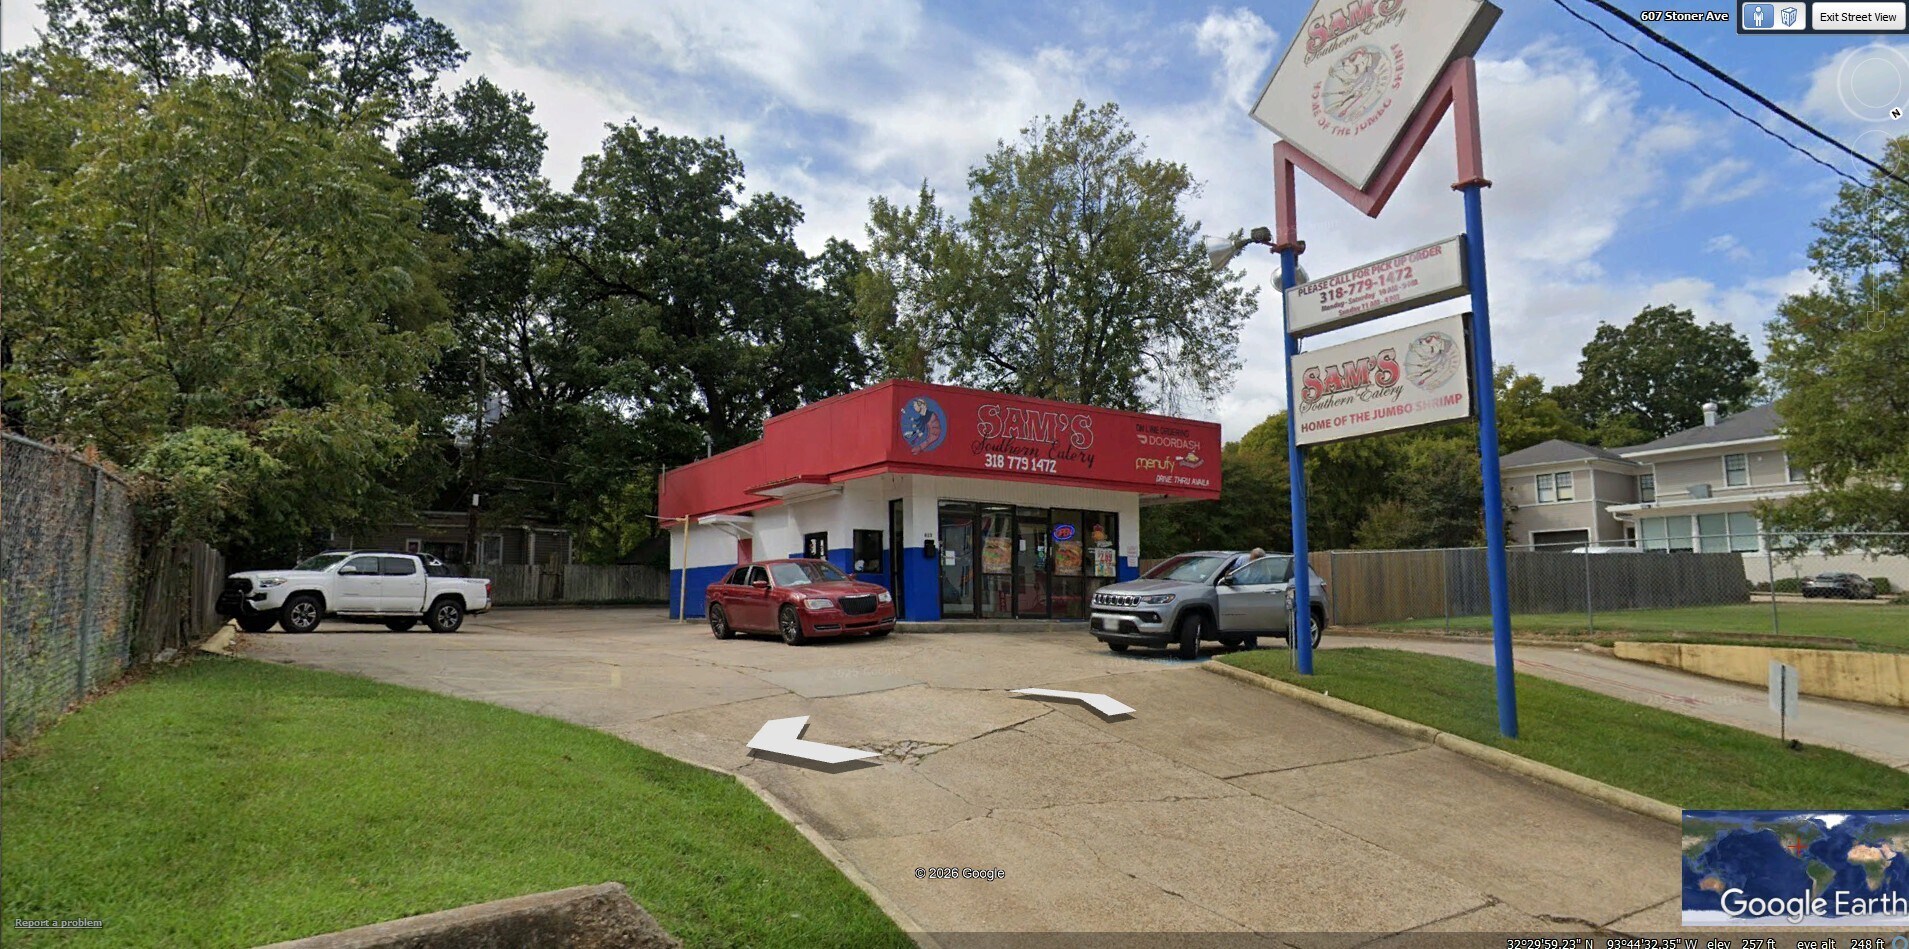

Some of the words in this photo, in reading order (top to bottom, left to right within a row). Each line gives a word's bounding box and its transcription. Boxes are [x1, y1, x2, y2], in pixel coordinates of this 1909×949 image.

[1306, 0, 1403, 54] SAM
[1304, 33, 1359, 67] Southern
[1298, 280, 1328, 297] PLEASE
[1328, 274, 1351, 289] CALL
[1352, 267, 1372, 281] FOR
[1371, 261, 1393, 275] PICK
[1394, 256, 1408, 268] UP
[1409, 245, 1443, 263] ORDER
[1320, 266, 1414, 303] 318-779-1472
[1301, 347, 1400, 404] SAM'S
[1299, 389, 1354, 416] Southern
[1356, 383, 1404, 403] Eatery
[1301, 418, 1331, 433] HOME
[1333, 415, 1348, 427] OF
[1348, 411, 1371, 425] THE
[1372, 403, 1413, 420] JUMBO
[1415, 392, 1463, 412] SHRIMP
[977, 404, 1094, 450] SAM'S
[1149, 436, 1200, 451] DOORDASH
[971, 434, 1039, 458] Southern
[984, 453, 1005, 469] 318
[1007, 456, 1029, 471] 779
[1031, 458, 1057, 473] 1472
[1135, 456, 1175, 473] menufy
[1156, 475, 1172, 484] DRIVE
[1174, 476, 1190, 485] THRU
